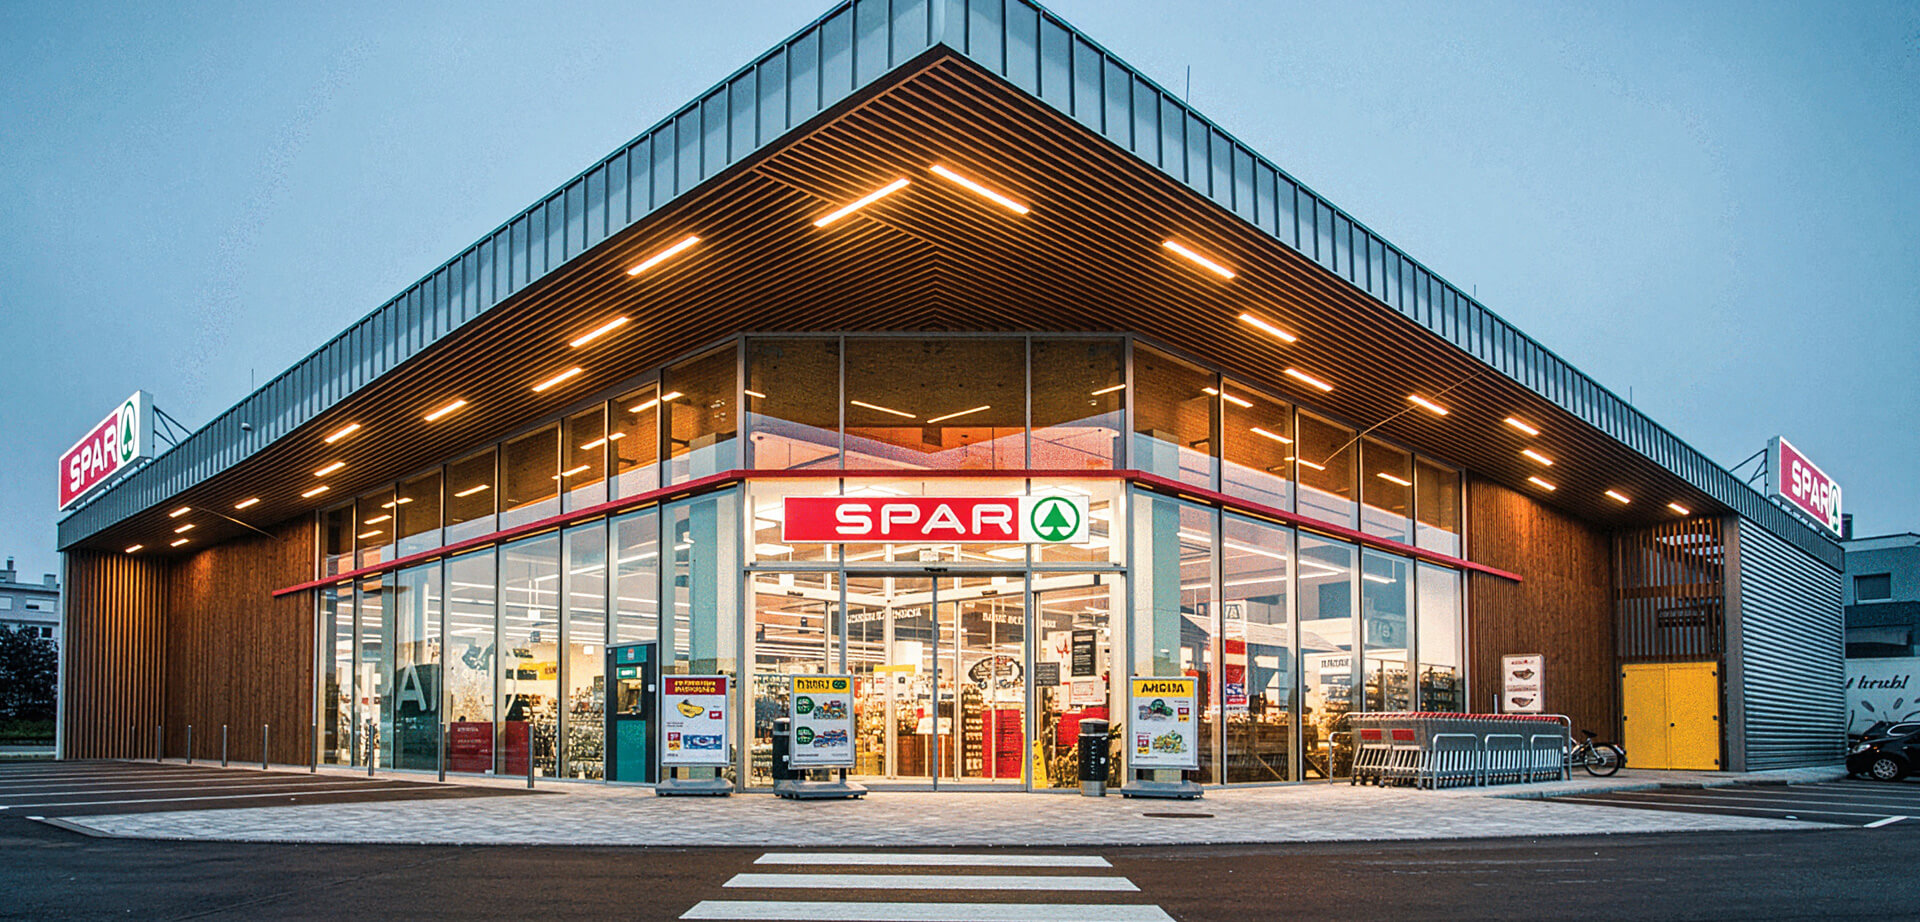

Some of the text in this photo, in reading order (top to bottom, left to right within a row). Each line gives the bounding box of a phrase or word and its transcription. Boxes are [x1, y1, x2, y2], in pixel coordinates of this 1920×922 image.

[70, 424, 117, 493] SPAR
[835, 503, 1013, 535] SPAR
[1791, 460, 1829, 519] SPAR
